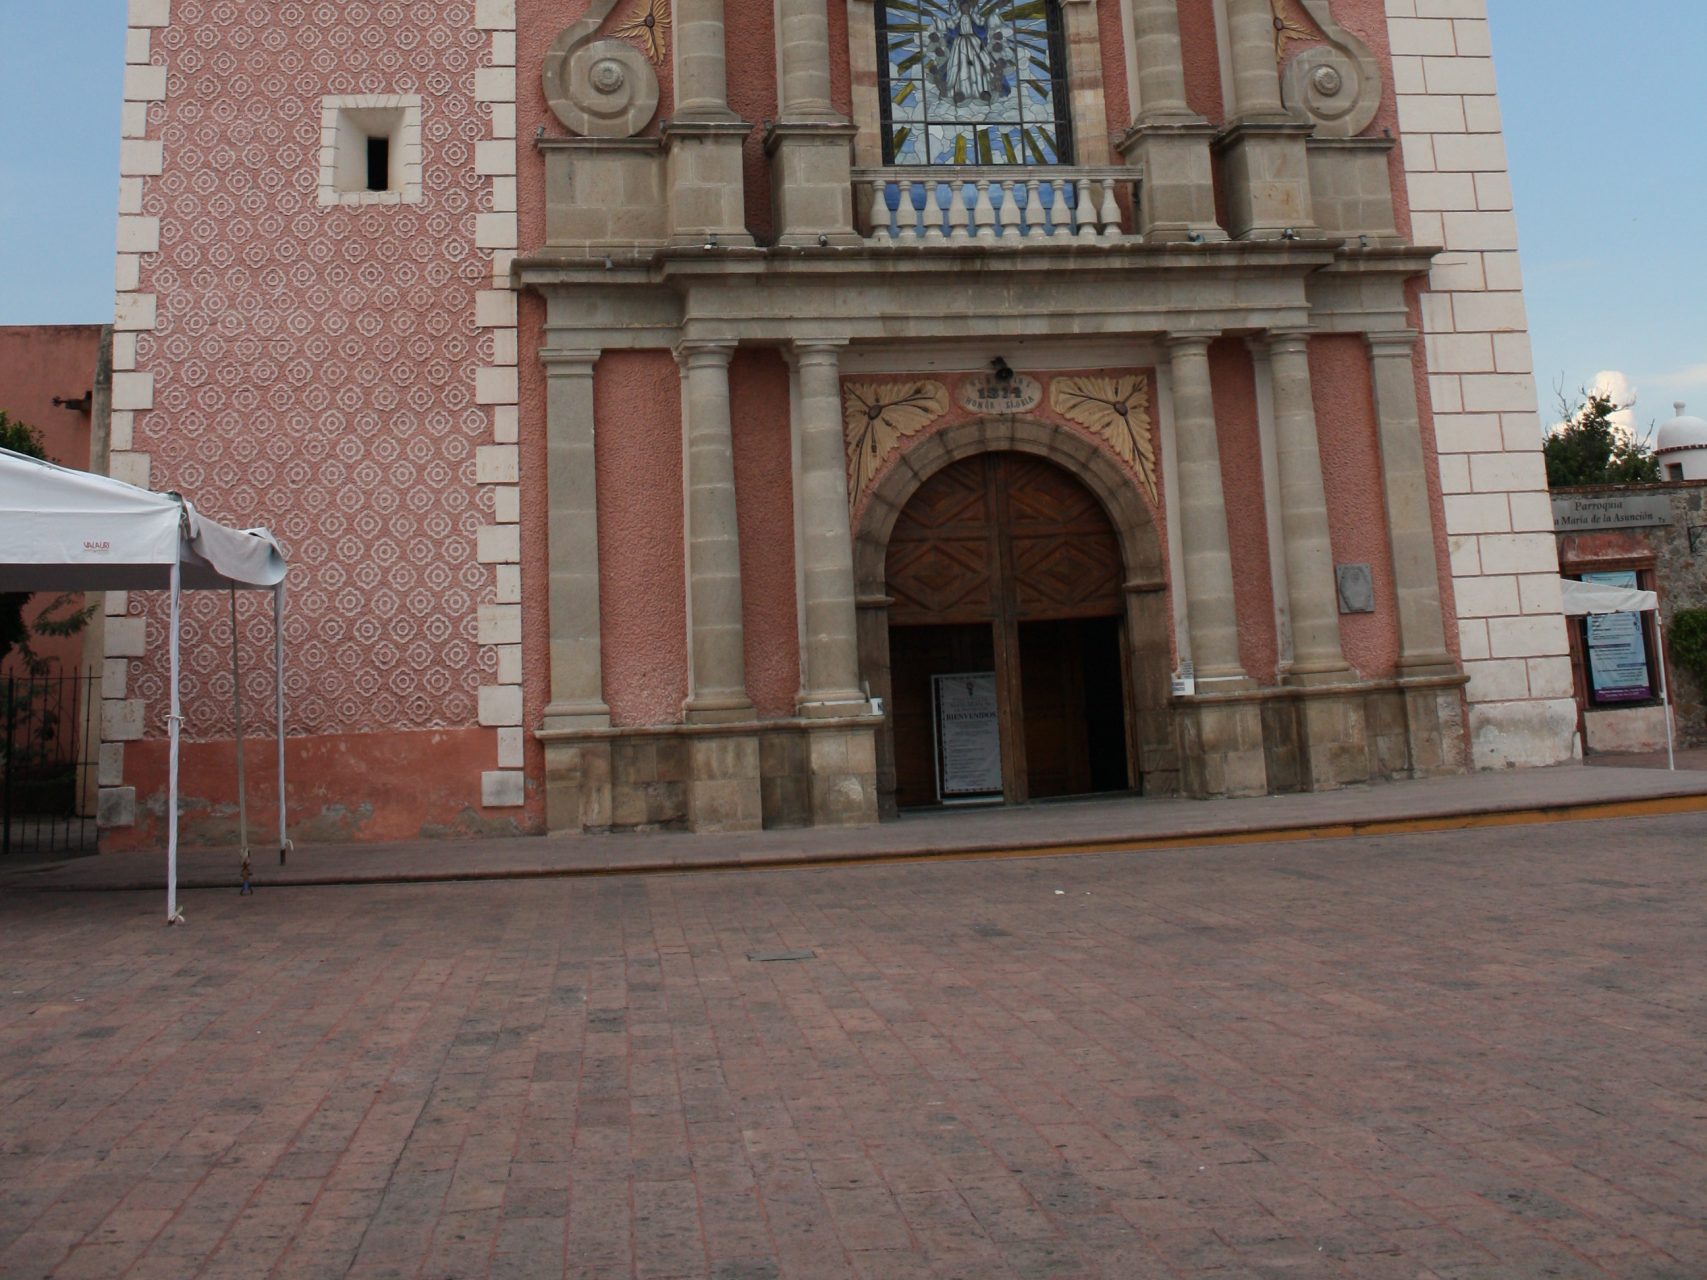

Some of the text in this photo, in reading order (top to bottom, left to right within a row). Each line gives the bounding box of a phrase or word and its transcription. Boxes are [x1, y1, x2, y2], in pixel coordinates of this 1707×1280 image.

[1575, 501, 1623, 512] Parroquia
[1591, 513, 1600, 524] de
[1602, 513, 1612, 523] la
